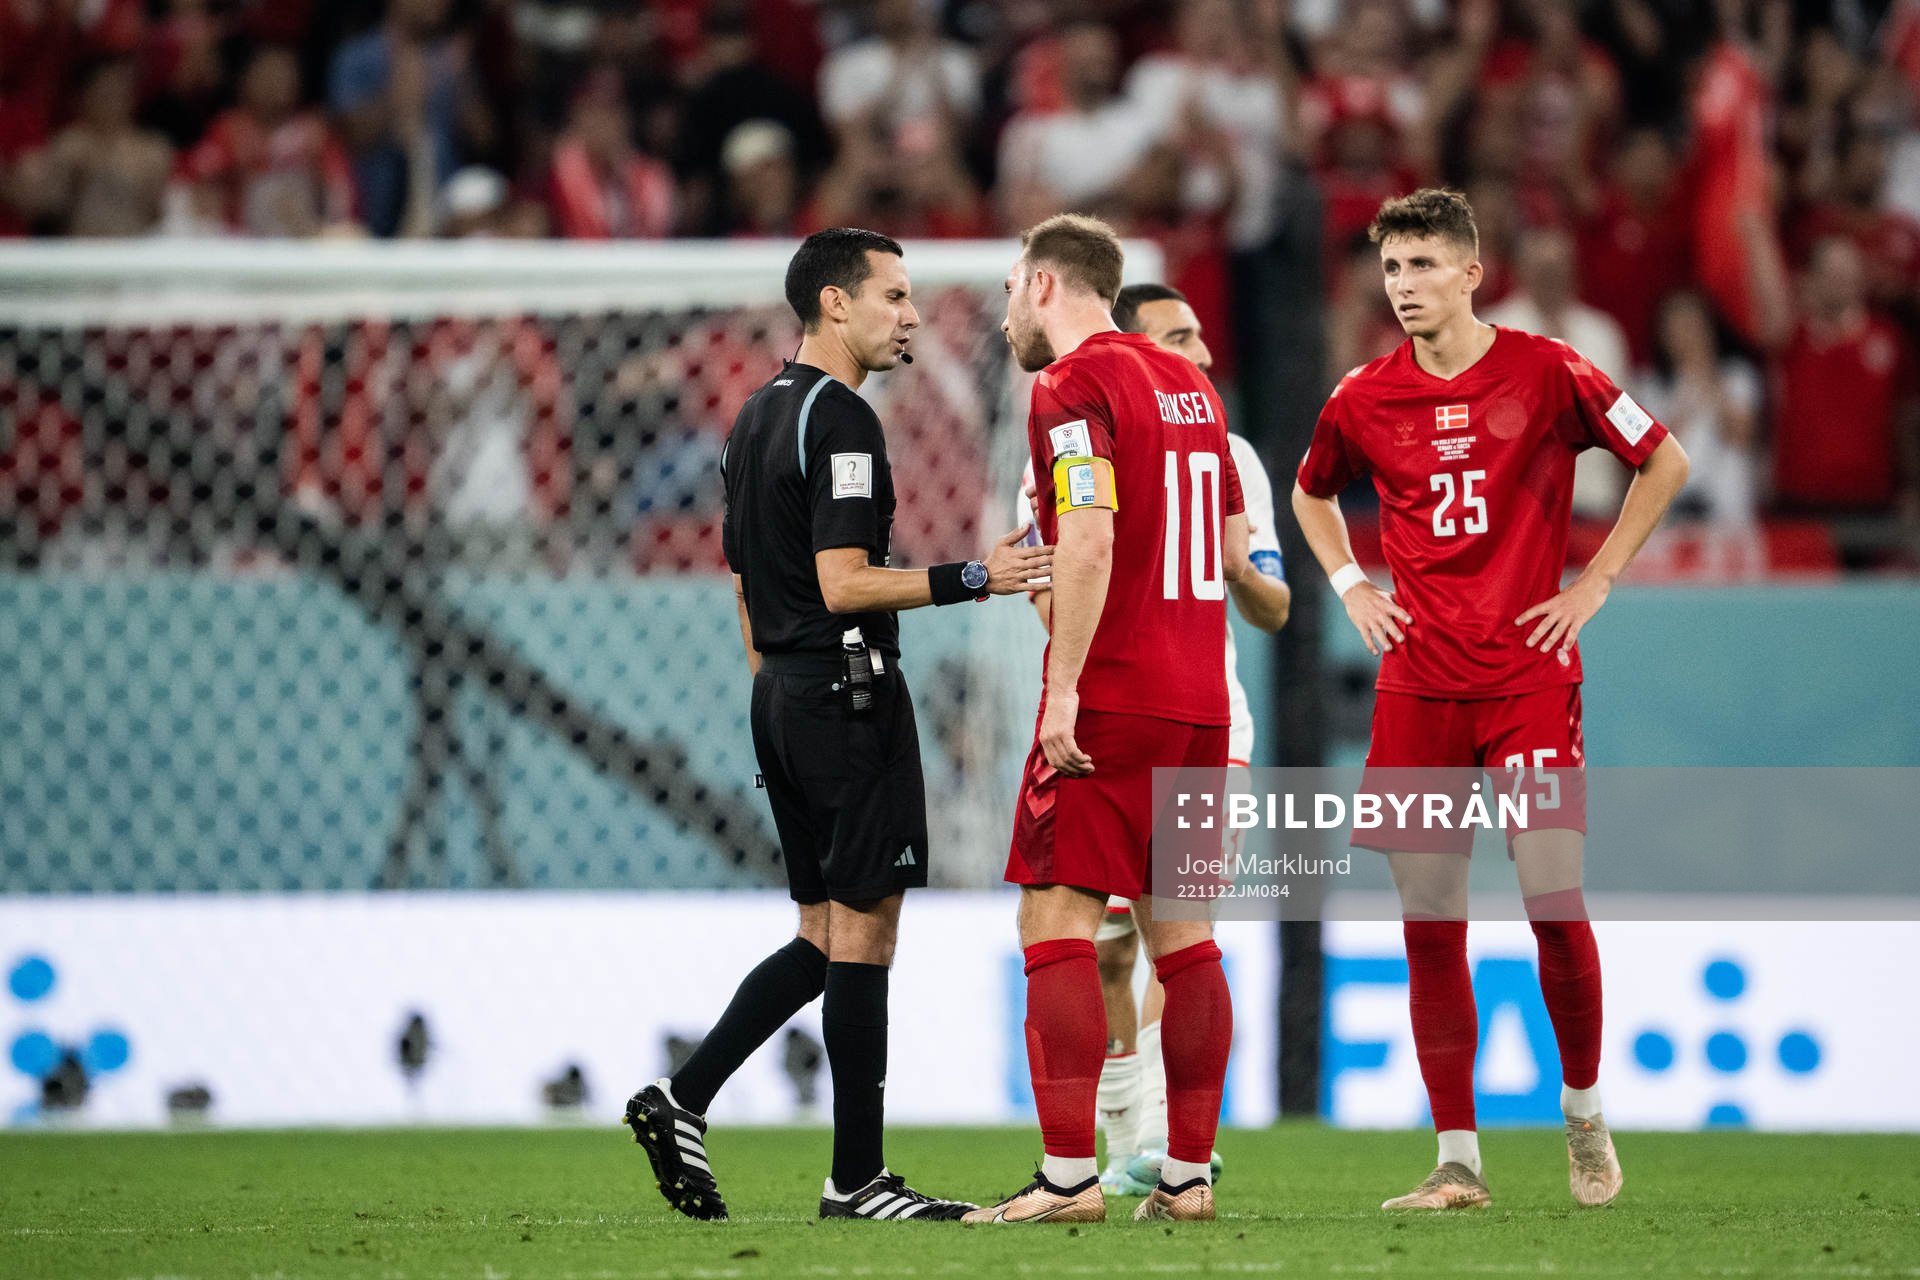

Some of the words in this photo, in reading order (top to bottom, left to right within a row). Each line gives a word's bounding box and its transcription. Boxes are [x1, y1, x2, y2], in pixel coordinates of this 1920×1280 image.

[1163, 451, 1225, 600] 10
[1430, 469, 1488, 537] 25
[1505, 748, 1561, 814] 25
